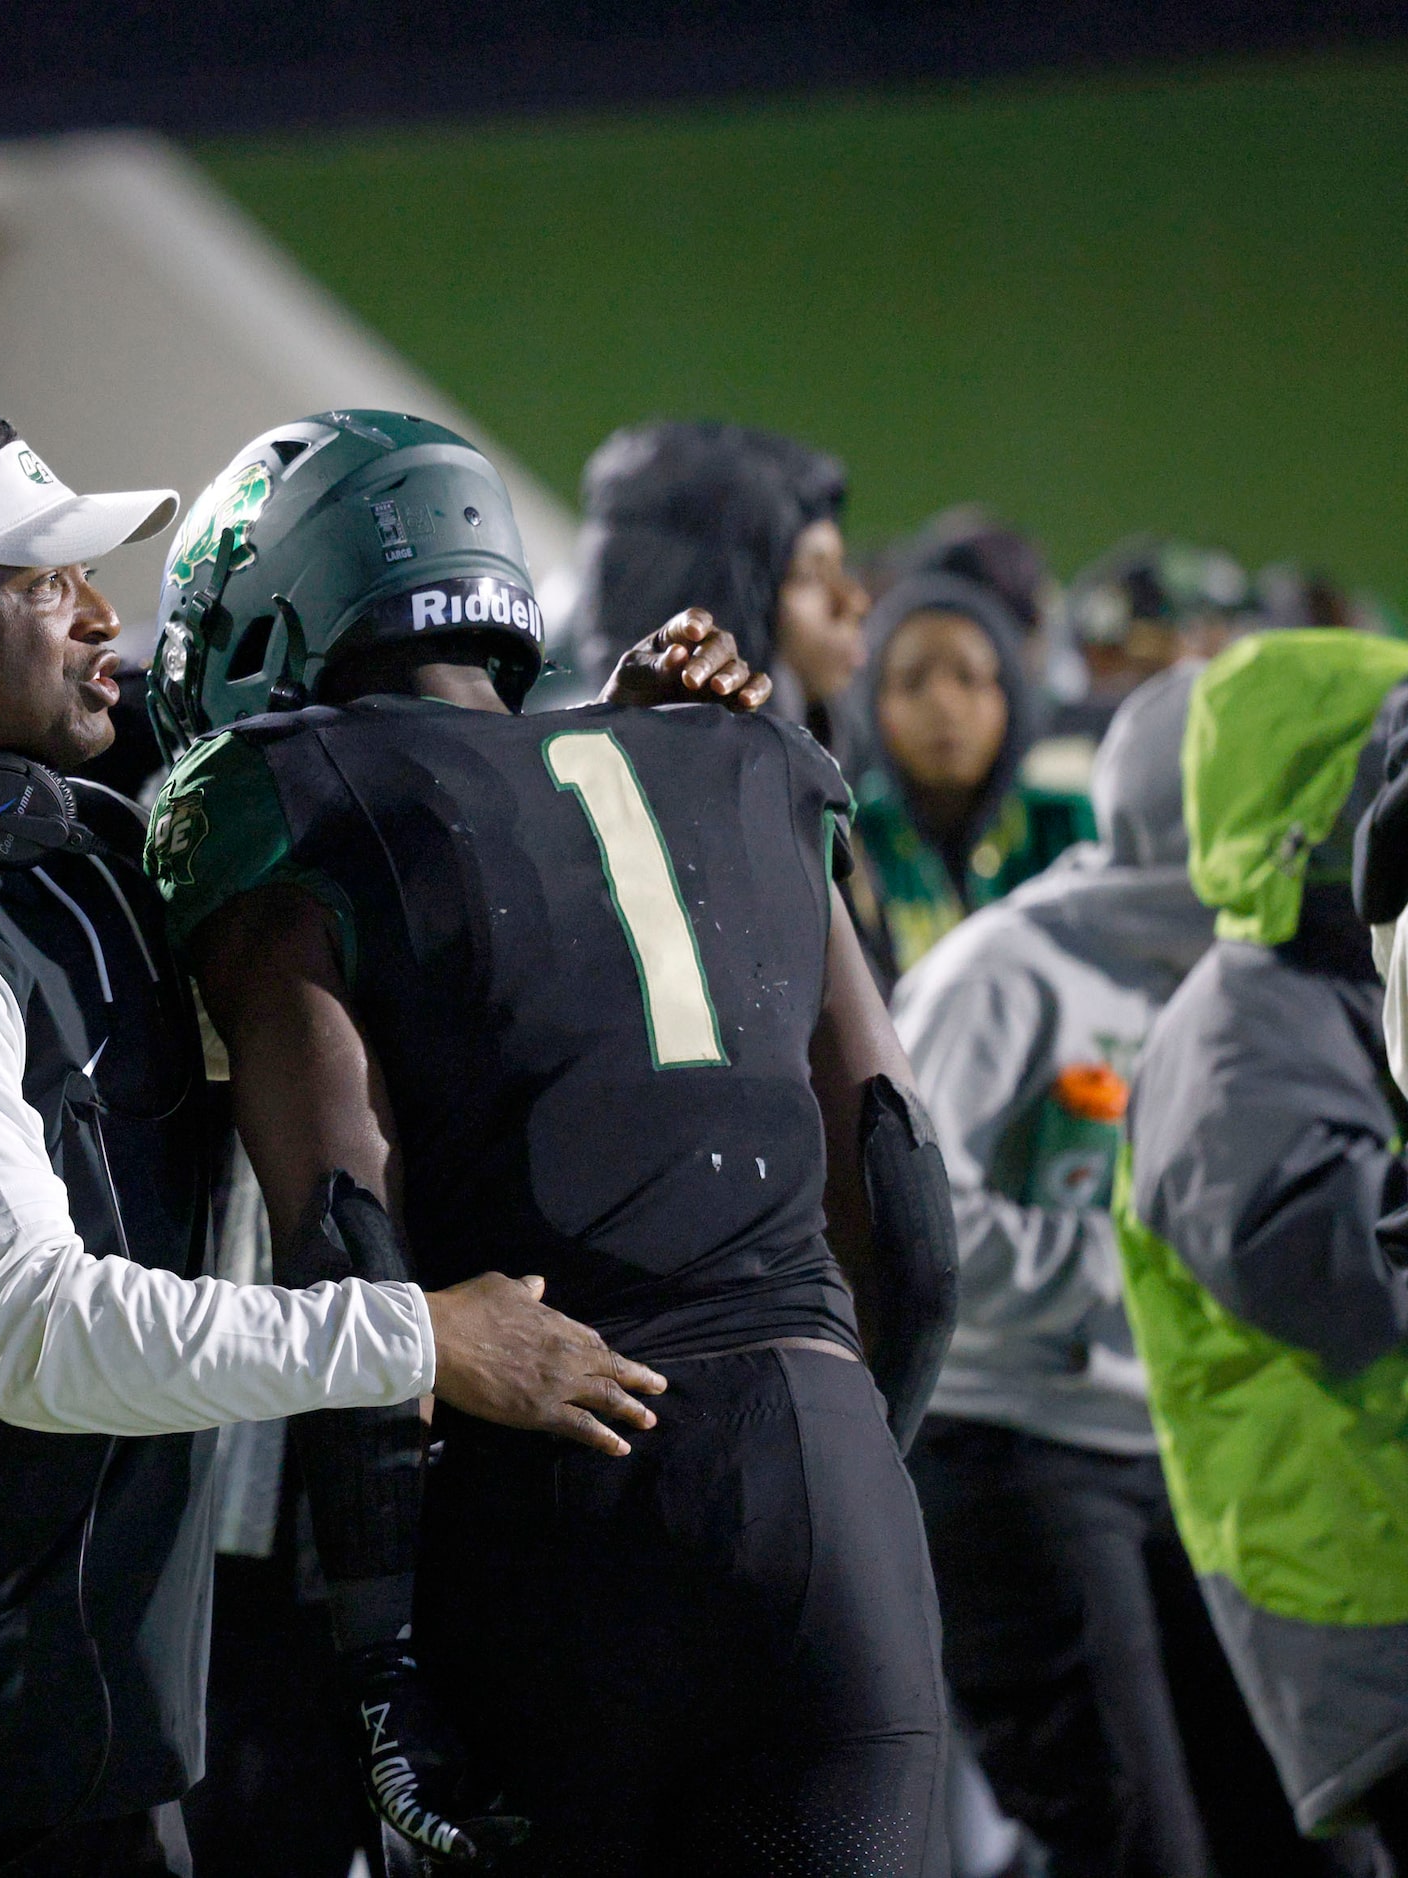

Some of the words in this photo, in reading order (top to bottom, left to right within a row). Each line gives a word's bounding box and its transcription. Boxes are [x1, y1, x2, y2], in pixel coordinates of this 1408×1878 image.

[385, 547, 413, 563] LARGE
[412, 588, 542, 643] Riddell
[541, 728, 731, 1072] 1
[371, 1756, 460, 1853] NXTRND
